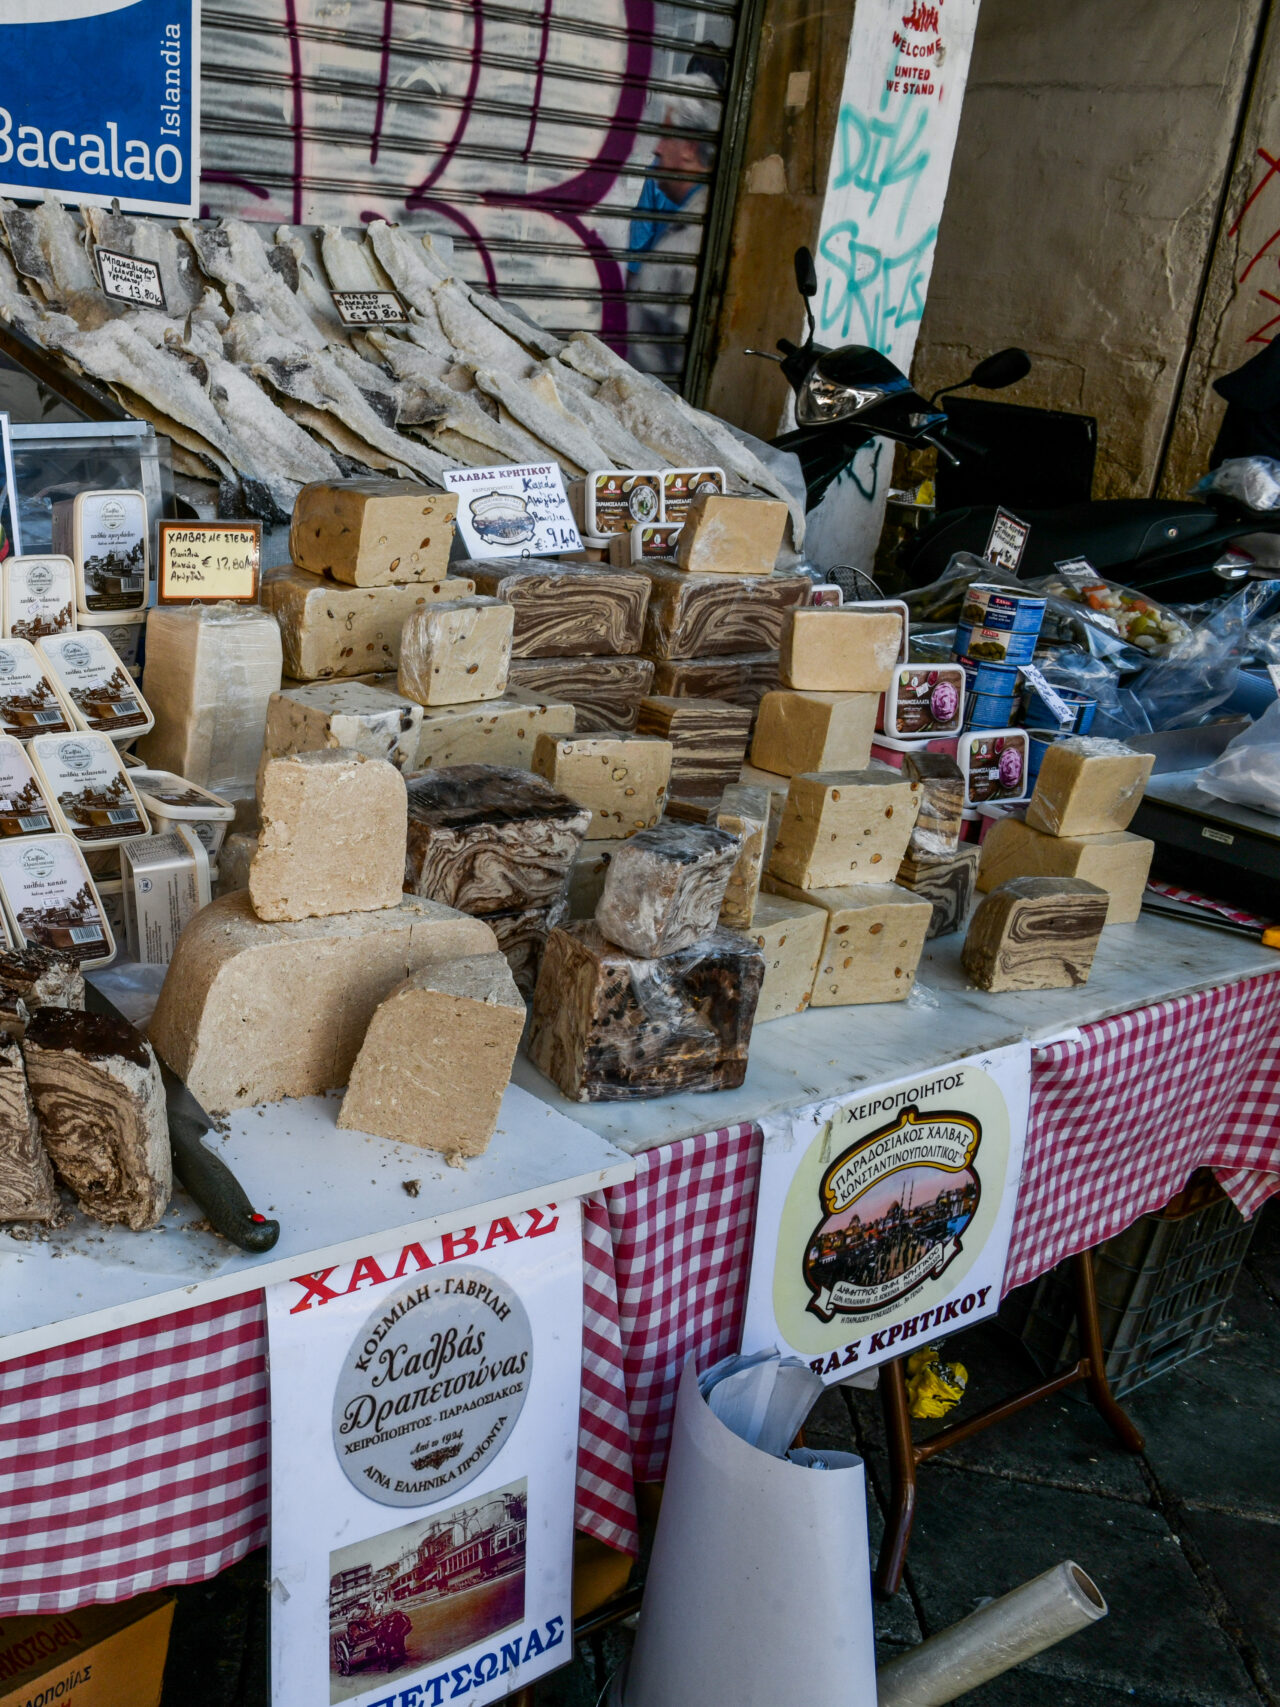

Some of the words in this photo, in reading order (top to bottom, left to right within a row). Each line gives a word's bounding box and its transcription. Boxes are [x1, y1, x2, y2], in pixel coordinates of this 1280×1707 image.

[892, 31, 942, 58] WELCOME
[160, 22, 182, 138] Islandia
[886, 80, 900, 92] WE
[903, 82, 934, 95] STAND
[894, 66, 931, 81] UNITED
[449, 471, 496, 483] ΧΑΛΒΑΣ
[499, 466, 552, 479] ΚΡΗΤΙΚΟΥ
[167, 532, 207, 544] ΧΑΛΒΑΣ
[225, 533, 255, 544] ΣΤΕΒΙΑ
[847, 1072, 965, 1124] ΧΕΙΡΟΠΟΙΗΤΟΣ
[835, 1126, 924, 1190] ΠΑΡΑΔΟΣΙΑΚΟΣ
[926, 1125, 970, 1148] ΧΑΛΒΑΣ
[840, 1145, 961, 1202] ΚΩΝΣΤΑΝΤΙΝΟΥΠΟΛΙΤΙΚΟΣ
[289, 1202, 560, 1315] ΧΑΛΒΑΣ
[355, 1285, 431, 1373] ΚΟΣΜΙΔΗ
[444, 1278, 512, 1323] ΓΑΒΡΙΛΗ
[810, 1340, 861, 1376] ΒΑΣ
[868, 1285, 992, 1358] ΚΡΗΤΙΚΟΥ
[371, 1324, 486, 1388] Χαλβάς
[344, 1415, 433, 1456] ΧΕΙΡΟΠΟΙΗΤΟΣ
[439, 1382, 524, 1422] ΠΑΡΑΔΟΣΙΑΚΟΣ
[441, 1428, 464, 1445] 1924
[363, 1465, 392, 1490] ΑΓΝΑ
[394, 1470, 457, 1493] ΕΛΛΗΝΙΚΑ
